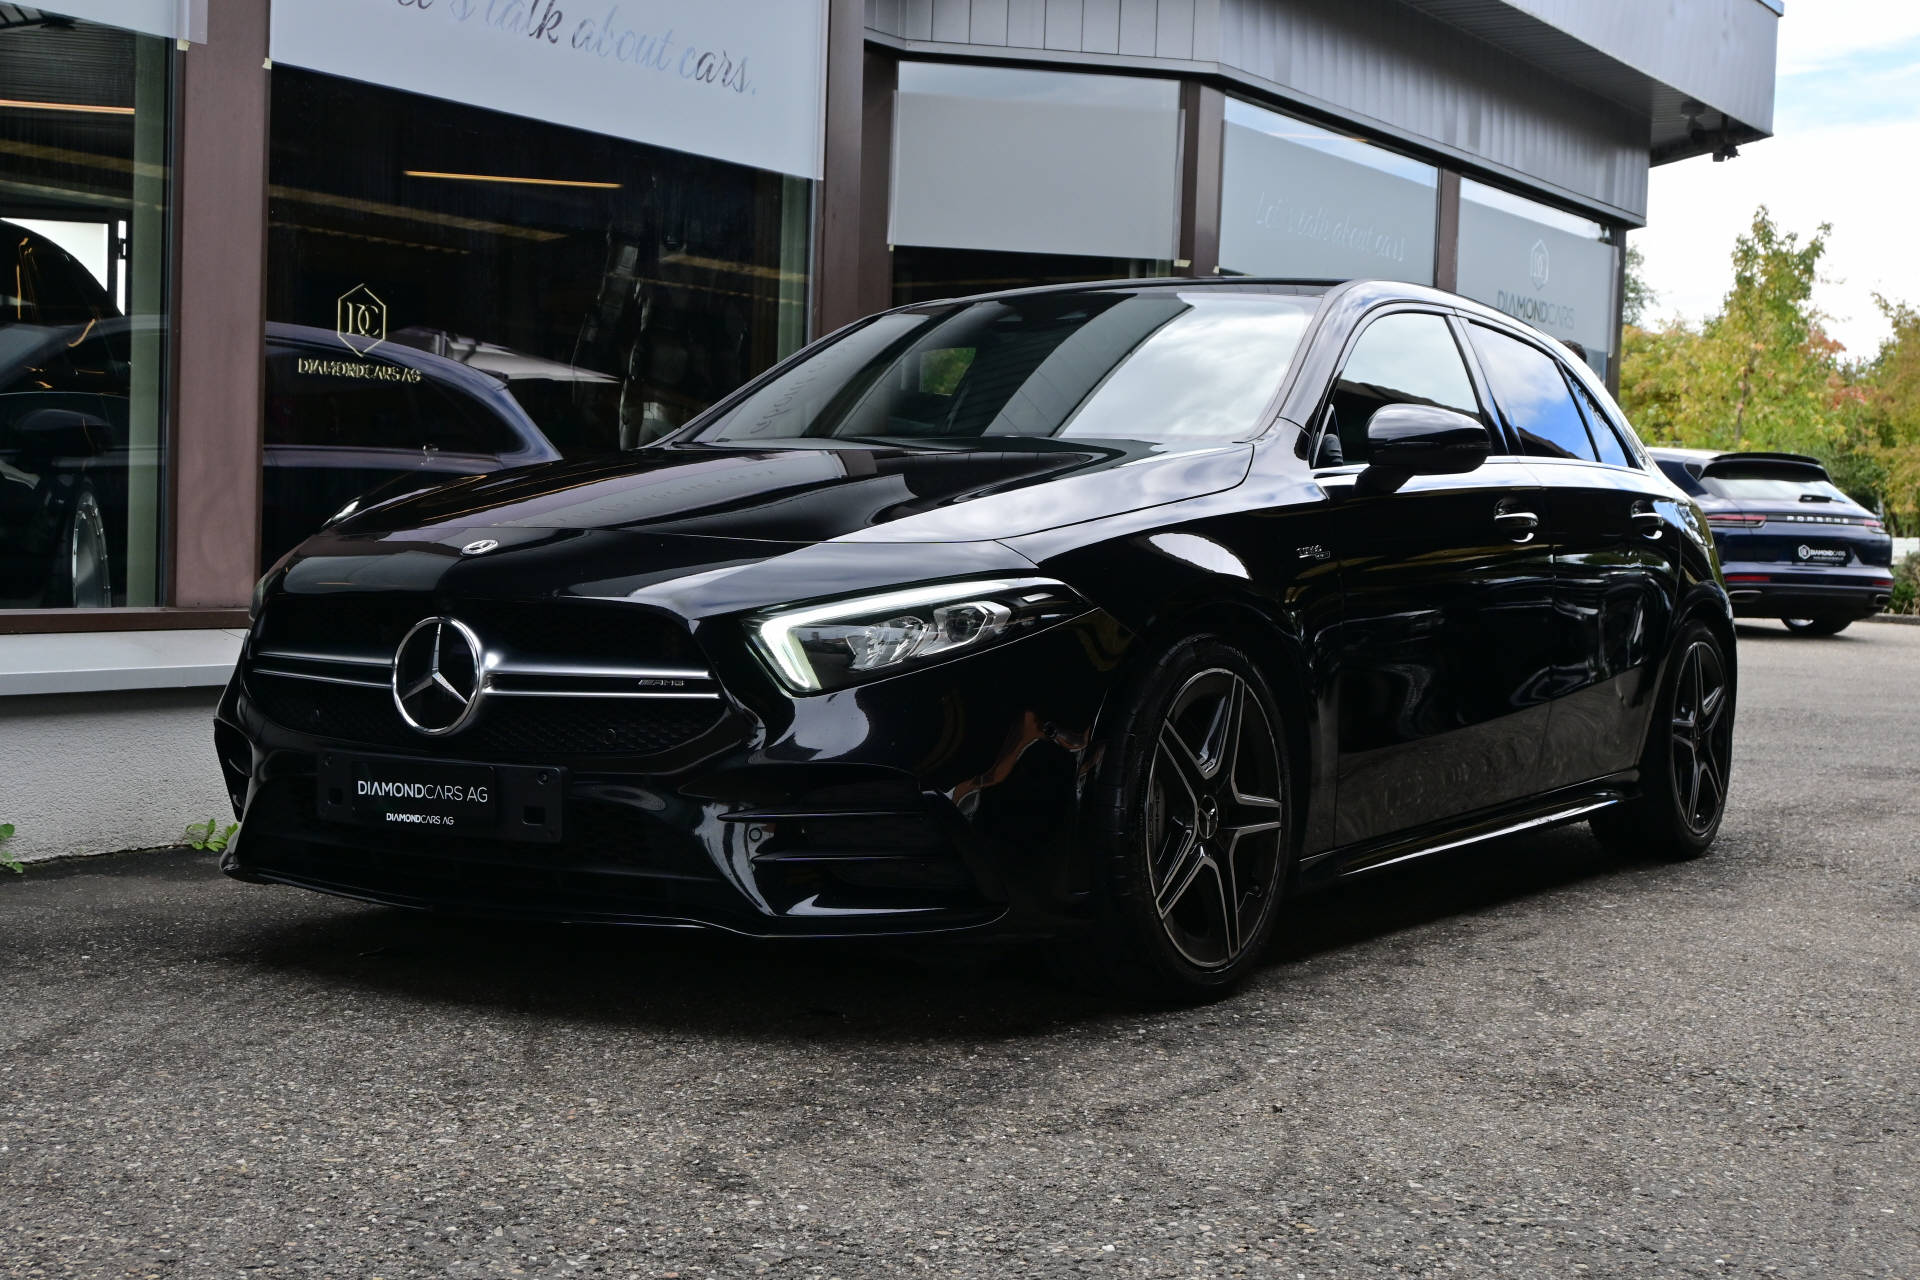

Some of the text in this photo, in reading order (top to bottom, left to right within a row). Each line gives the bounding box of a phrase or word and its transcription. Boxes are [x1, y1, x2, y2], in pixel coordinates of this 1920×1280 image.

[571, 4, 674, 71] about
[679, 45, 757, 95] cars.
[1497, 289, 1575, 330] DIAMONDCARS
[1787, 516, 1848, 524] PORSCHE
[357, 780, 488, 803] DIAMONDCARS AG
[386, 812, 455, 826] DIAMONDCARS AG
